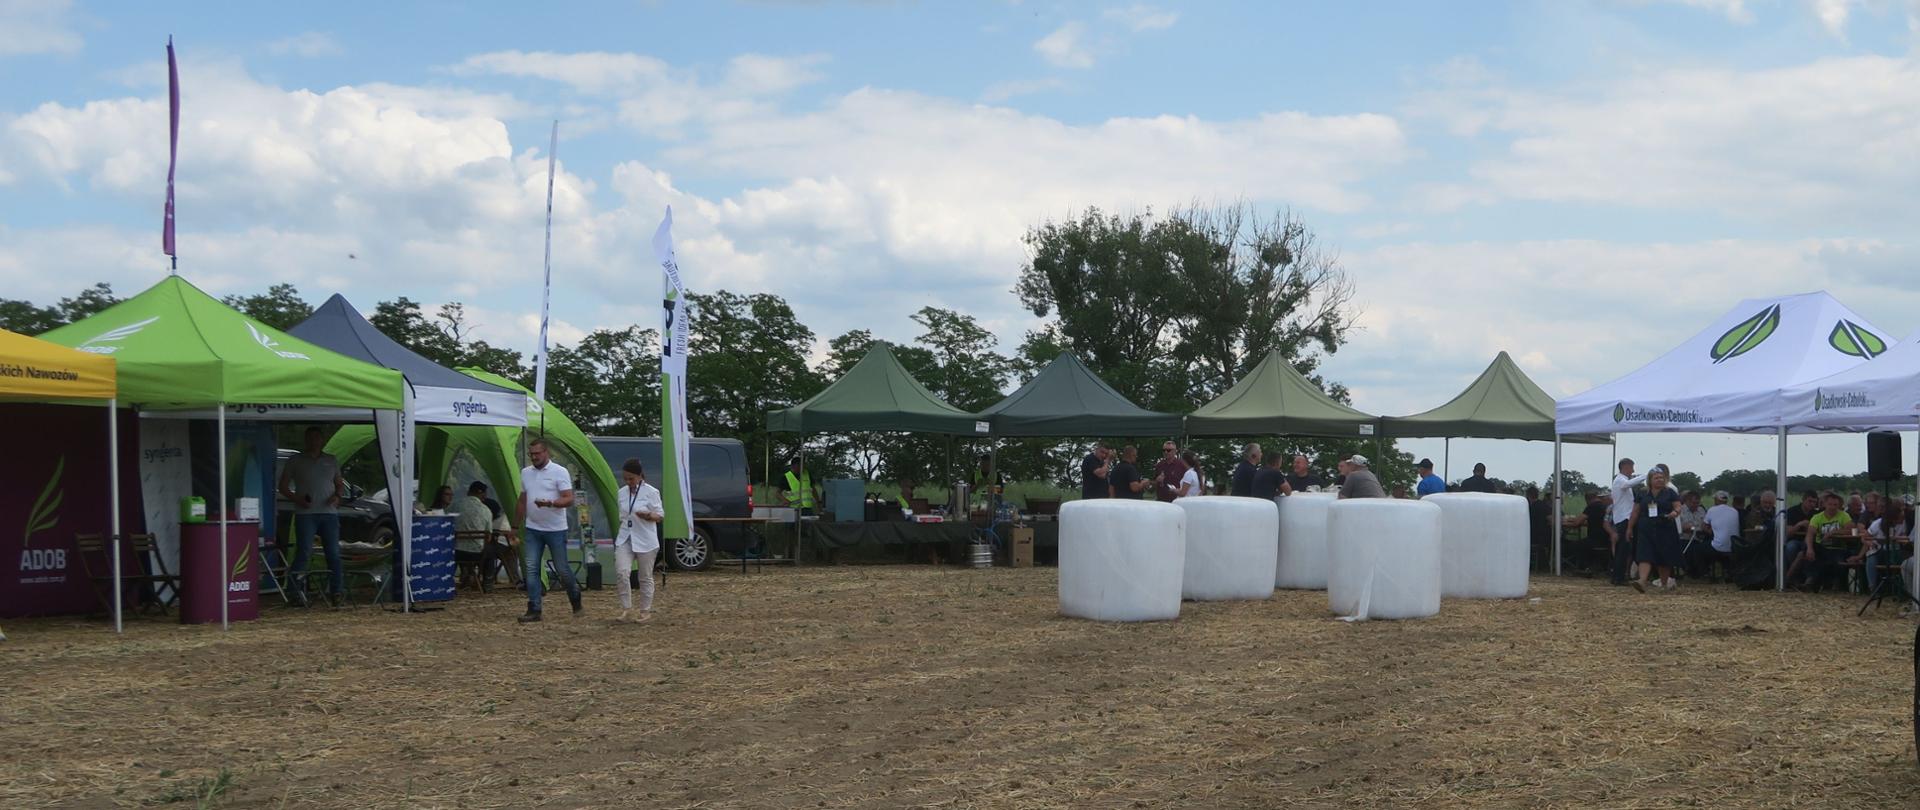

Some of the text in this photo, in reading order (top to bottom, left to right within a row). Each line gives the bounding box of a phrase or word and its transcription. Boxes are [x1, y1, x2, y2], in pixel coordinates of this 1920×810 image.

[0, 363, 79, 382] kich Nawozów
[453, 400, 488, 418] syngenta
[20, 548, 66, 571] ADOB
[228, 581, 251, 592] ADOB
